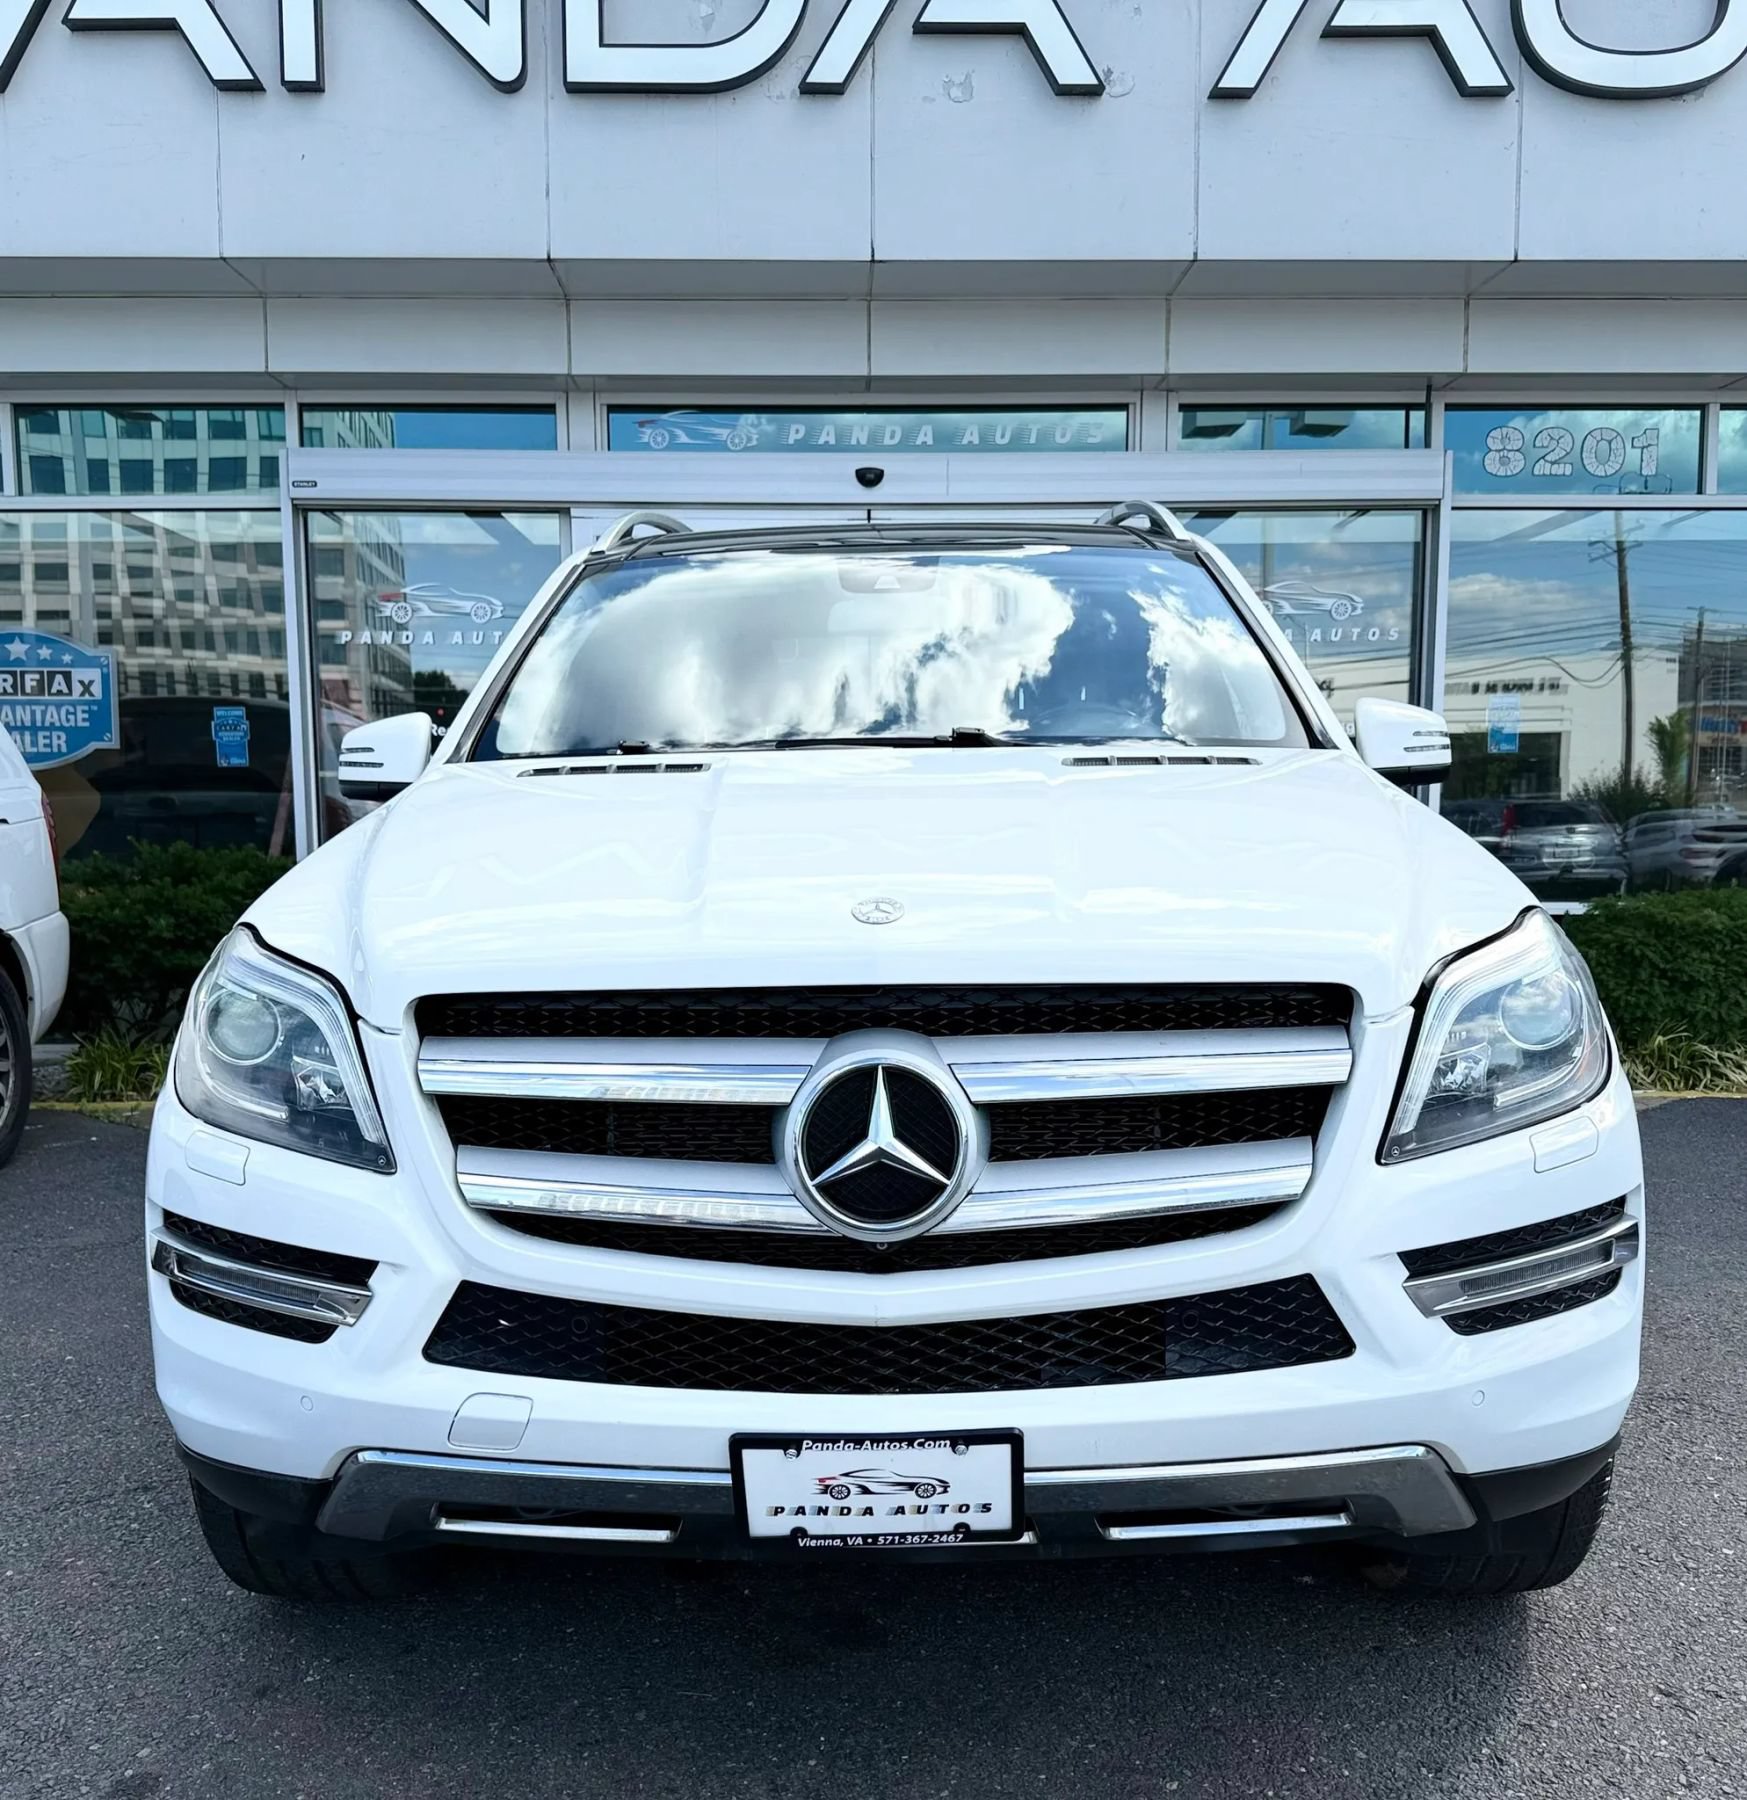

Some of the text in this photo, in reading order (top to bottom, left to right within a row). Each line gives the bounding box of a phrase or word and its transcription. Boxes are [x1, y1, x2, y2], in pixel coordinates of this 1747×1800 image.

[786, 422, 1104, 446] PANDA AUTOS
[1482, 426, 1660, 477] 8201
[340, 631, 435, 645] PANDA
[1310, 627, 1400, 642] AUTOS
[801, 1438, 951, 1452] Panda-Autos.Com
[772, 1502, 993, 1517] PANDA AUTOS
[797, 1533, 964, 1548] Vienna, VA 571-367-2467
